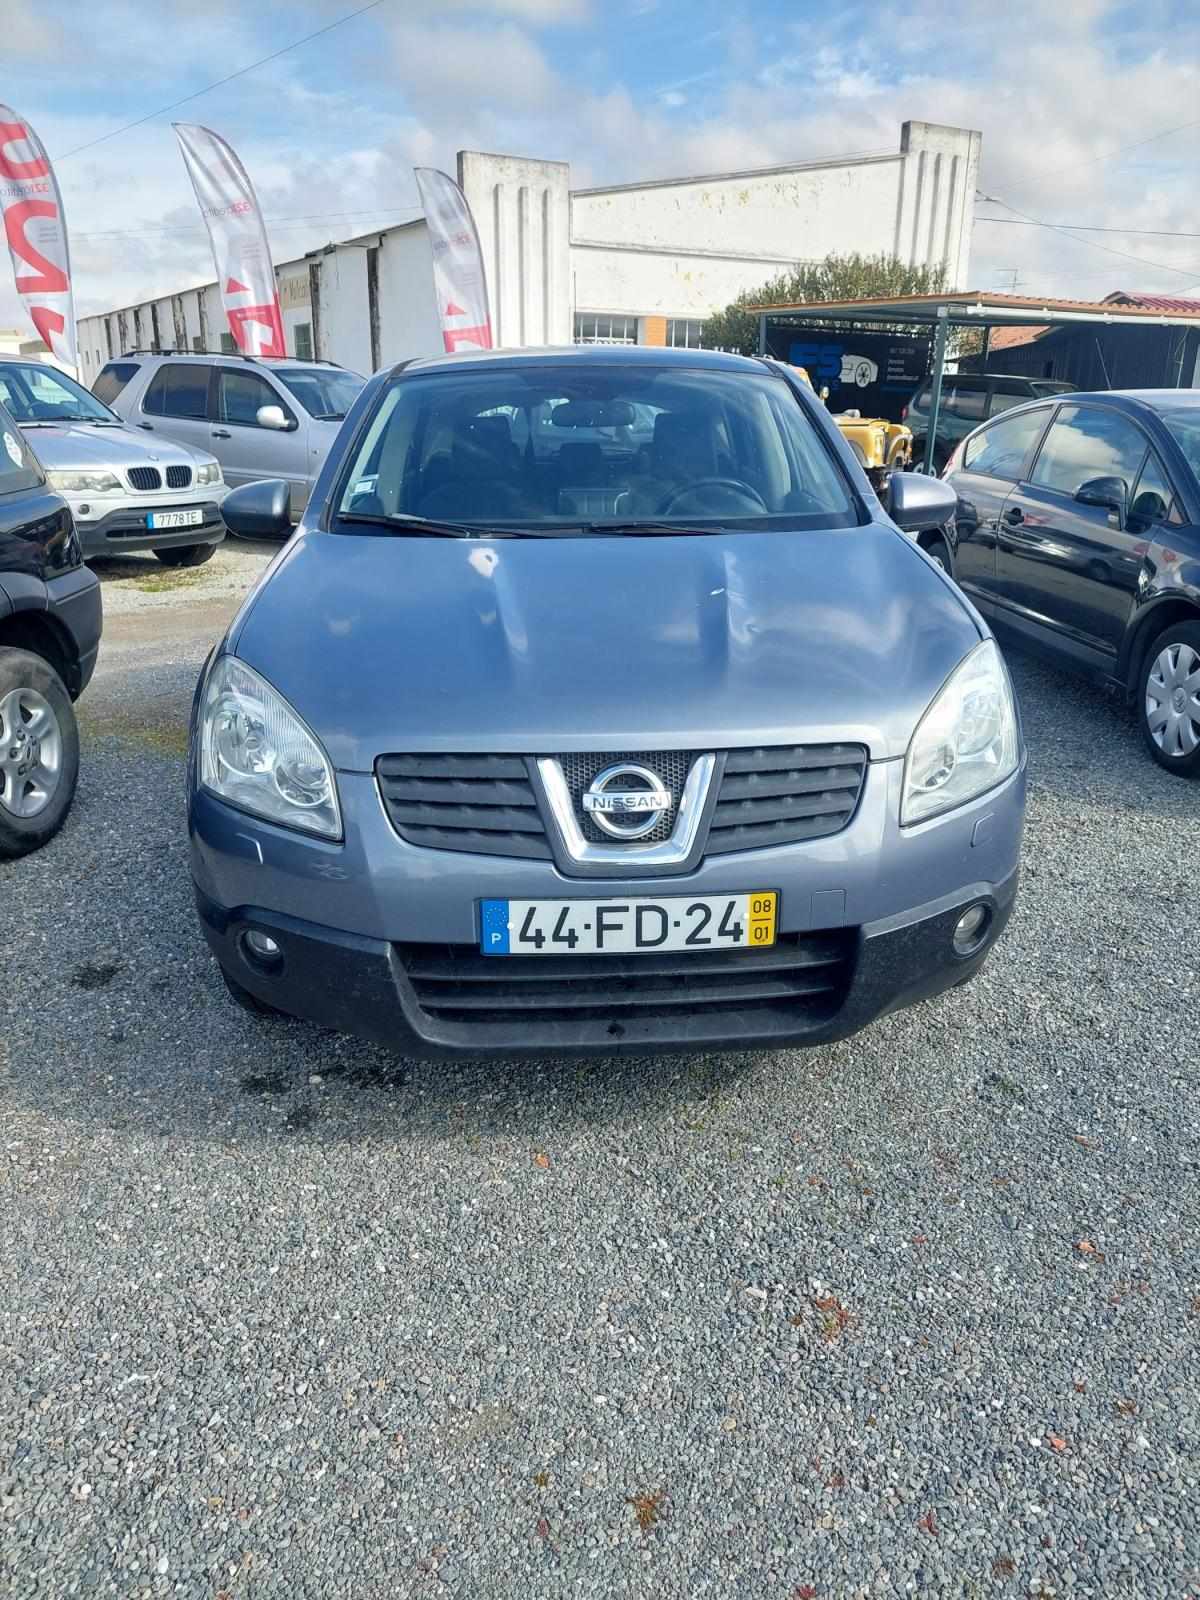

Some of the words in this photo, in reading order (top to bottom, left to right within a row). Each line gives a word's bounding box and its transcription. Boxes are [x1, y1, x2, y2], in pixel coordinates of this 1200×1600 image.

[593, 796, 662, 808] NISSAN
[753, 899, 771, 913] 08
[491, 933, 502, 944] P
[754, 926, 769, 940] 01
